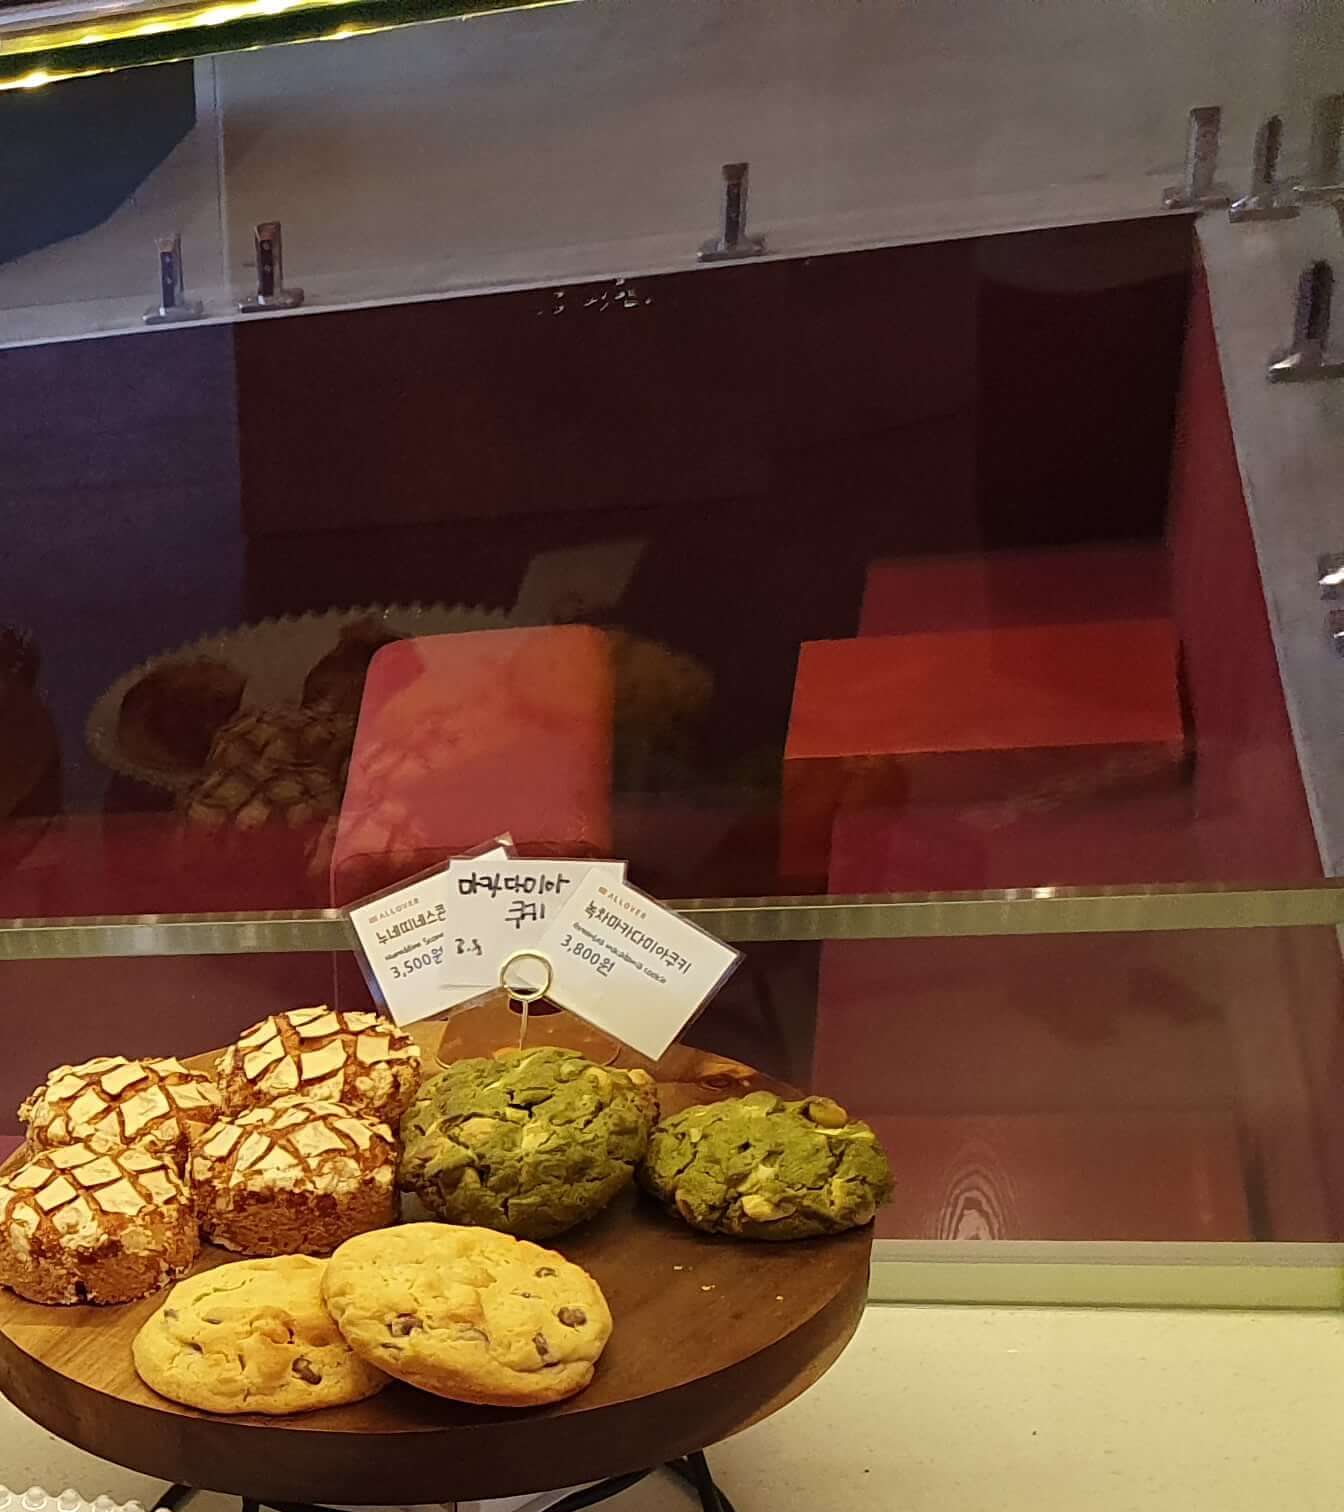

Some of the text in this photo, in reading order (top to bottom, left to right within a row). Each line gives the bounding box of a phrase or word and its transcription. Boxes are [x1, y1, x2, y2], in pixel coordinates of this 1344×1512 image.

[458, 872, 570, 898] 마카다미아
[375, 903, 447, 945] 누네띠네스콘
[505, 900, 545, 929] 쿠키
[560, 933, 616, 977] 3,800원
[585, 900, 692, 974] 녹차마카다미아쿠키
[390, 946, 444, 979] 3,500원
